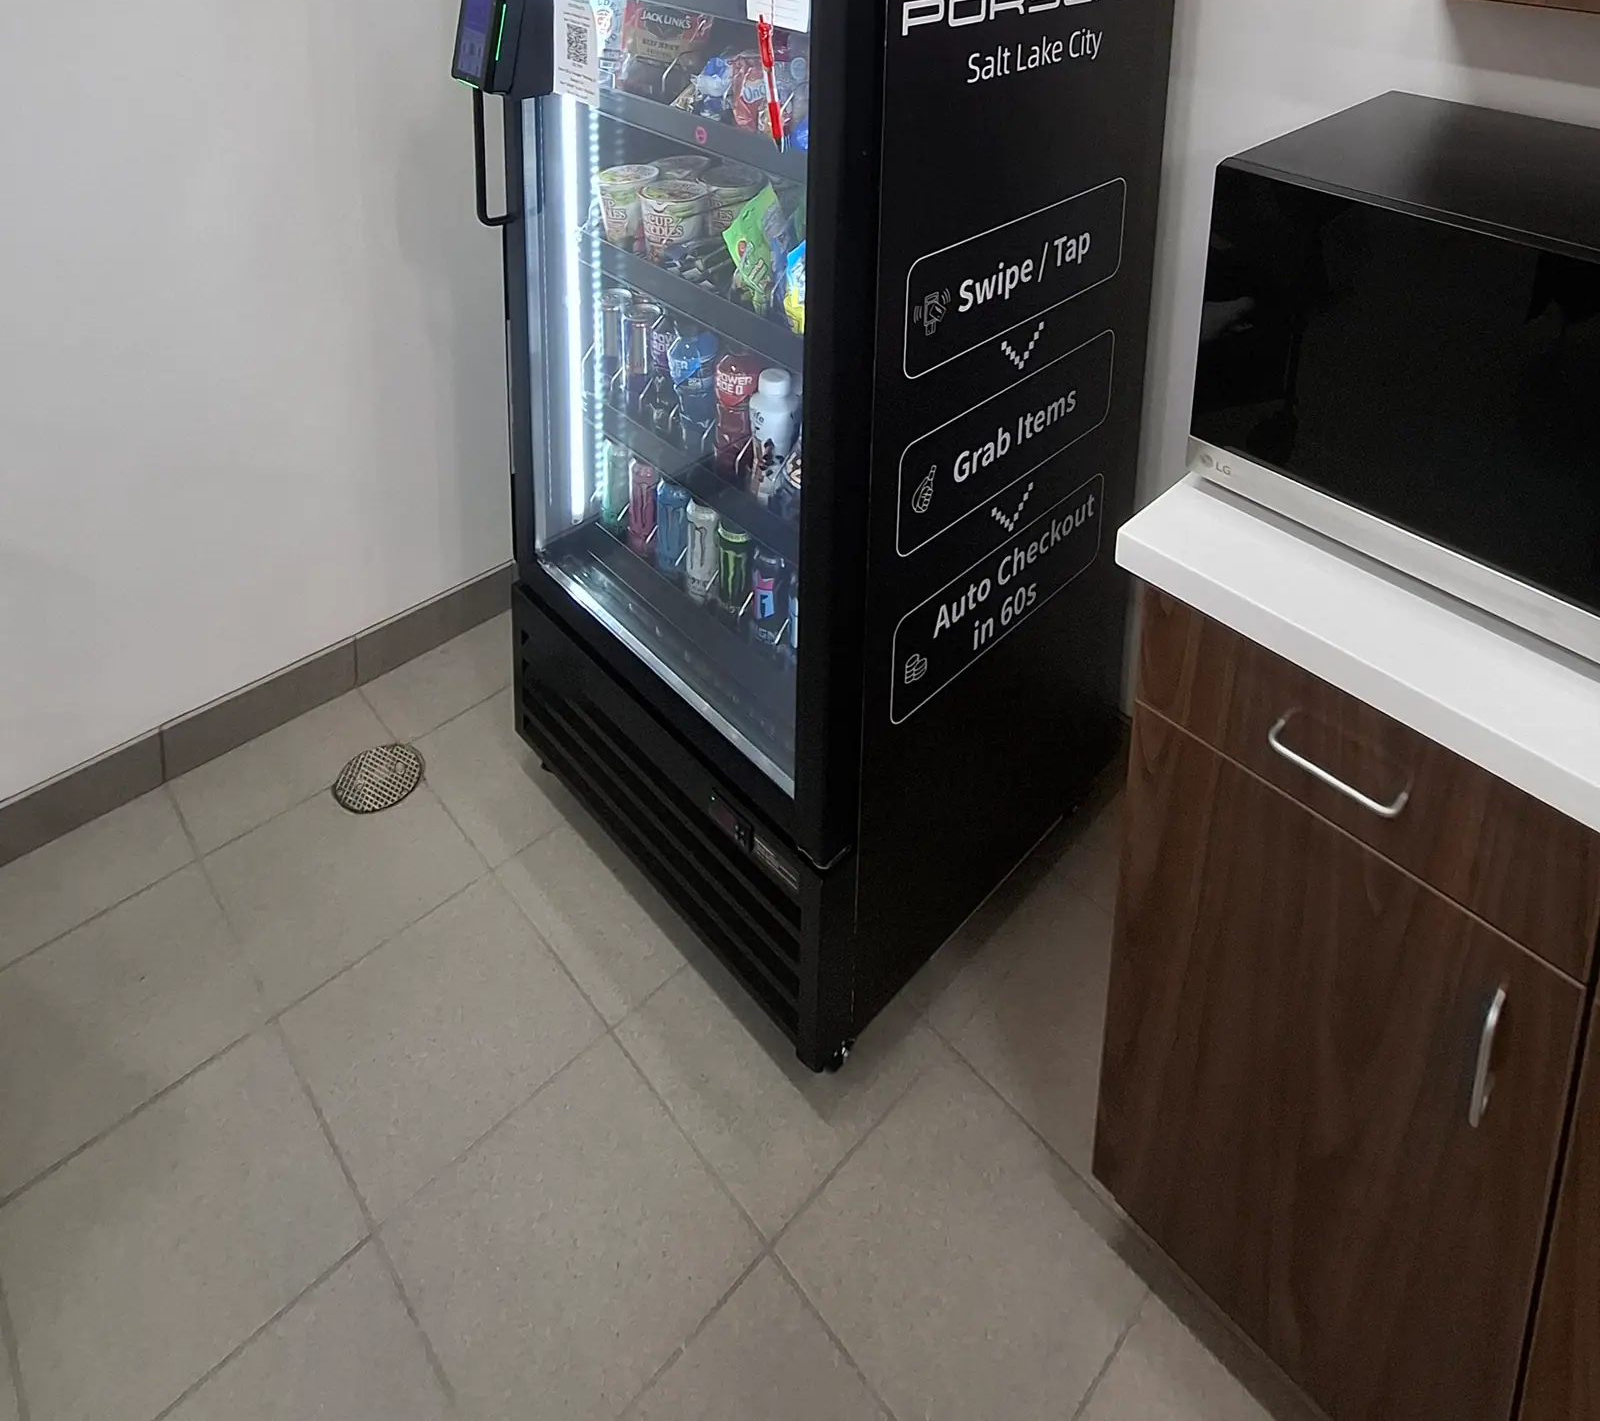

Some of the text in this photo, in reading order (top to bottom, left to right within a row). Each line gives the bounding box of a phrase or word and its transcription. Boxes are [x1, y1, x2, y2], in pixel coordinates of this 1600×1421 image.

[640, 9, 664, 24] JACK
[967, 28, 1103, 83] Salt Lake City
[647, 213, 673, 226] CUP
[957, 232, 1091, 313] Swipe / Tap
[953, 390, 1077, 482] Grab Items
[1215, 461, 1232, 476] LG
[932, 494, 1096, 639] Auto Checkout
[973, 582, 1037, 651] in 60s
